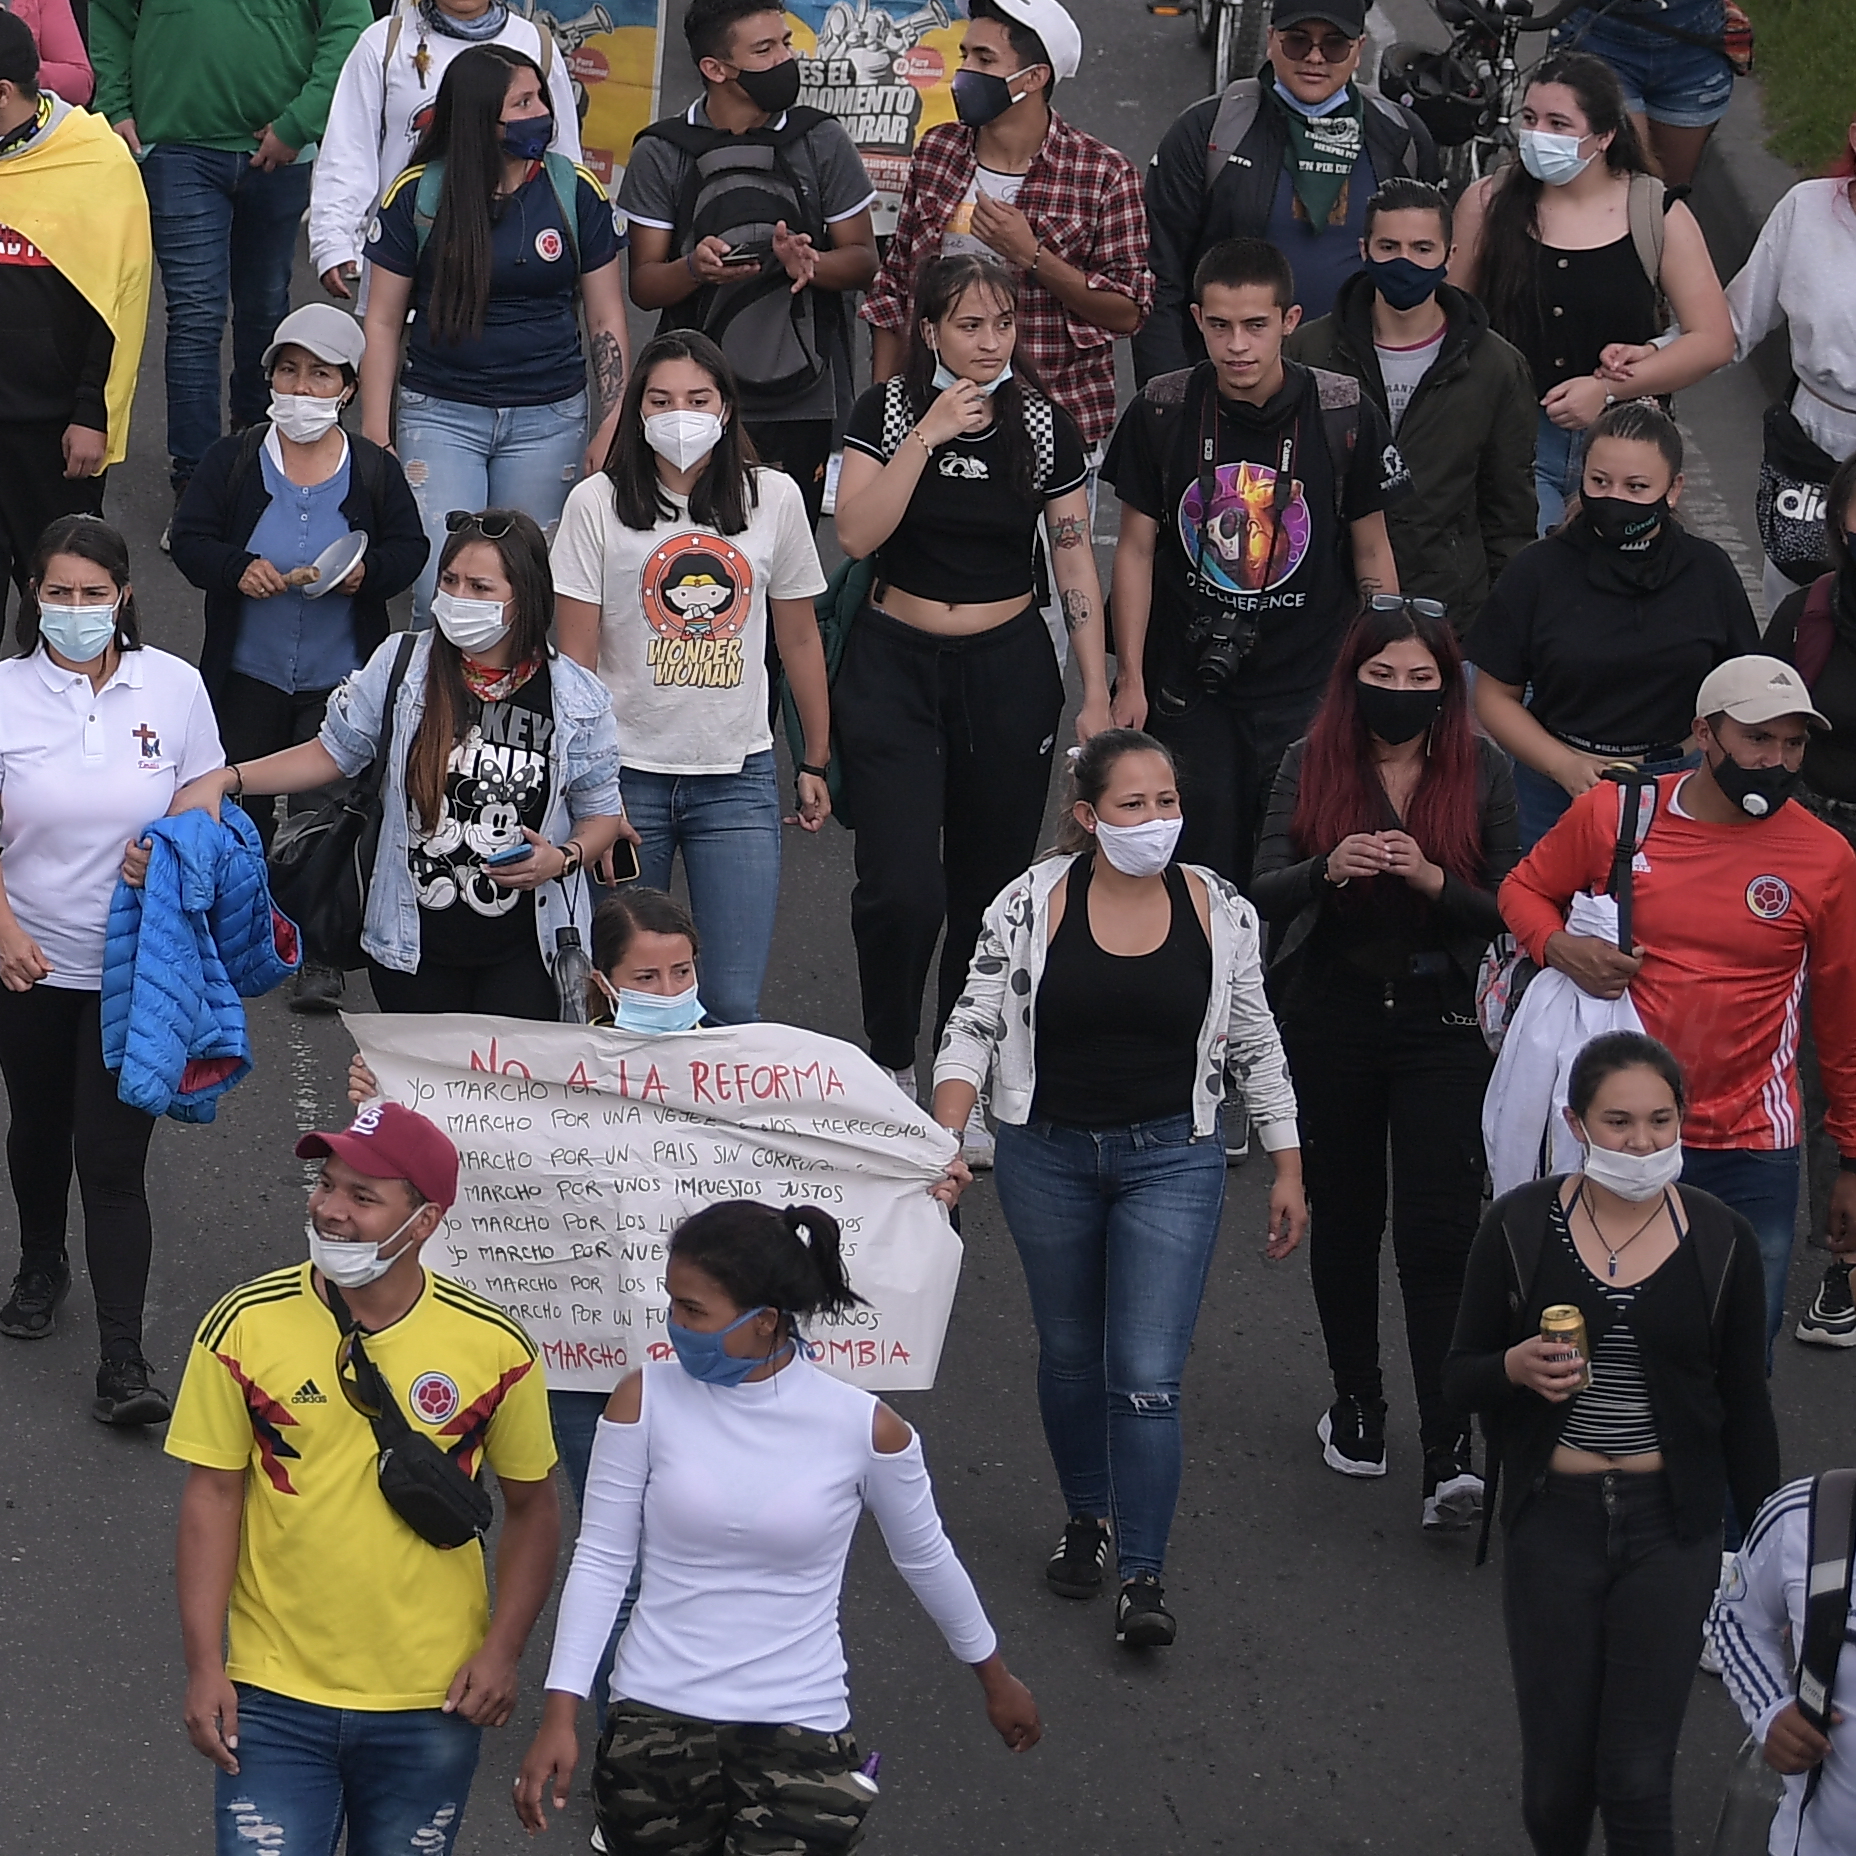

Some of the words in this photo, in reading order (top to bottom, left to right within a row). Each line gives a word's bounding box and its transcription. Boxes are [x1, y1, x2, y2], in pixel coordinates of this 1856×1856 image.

[799, 61, 824, 85] ES
[828, 62, 851, 86] EL
[797, 87, 915, 115] MOMENTO
[1315, 162, 1333, 173] PIE
[647, 638, 744, 664] WONDER
[654, 661, 744, 689] WOMAN
[444, 1079, 549, 1103] MARCHO
[688, 1060, 846, 1105] REFORMA
[446, 1113, 533, 1134] MARCHO
[549, 1107, 591, 1129] POR
[603, 1105, 642, 1127] UNA
[810, 1117, 928, 1140] MERECEMOS
[549, 1147, 596, 1168] POR
[604, 1144, 630, 1166] UN
[652, 1141, 698, 1166] PAIS
[713, 1144, 744, 1166] SIN
[464, 1185, 542, 1203] MARCHO
[555, 1180, 604, 1199] POR
[613, 1177, 663, 1194] UNOS
[674, 1177, 763, 1197] IMPUESTOS
[777, 1181, 844, 1204] JUSTOS
[470, 1215, 551, 1234] MARCHO
[562, 1213, 606, 1233] POR
[615, 1214, 647, 1233] LOS
[477, 1245, 555, 1264] MARCHO
[570, 1241, 613, 1261] POR
[487, 1276, 558, 1293] MARCHO
[570, 1276, 604, 1294] POR
[618, 1276, 647, 1294] LOS
[571, 1303, 603, 1324] POR
[613, 1308, 633, 1328] UN
[543, 1340, 628, 1371] MARCHO
[290, 1394, 328, 1405] adidas
